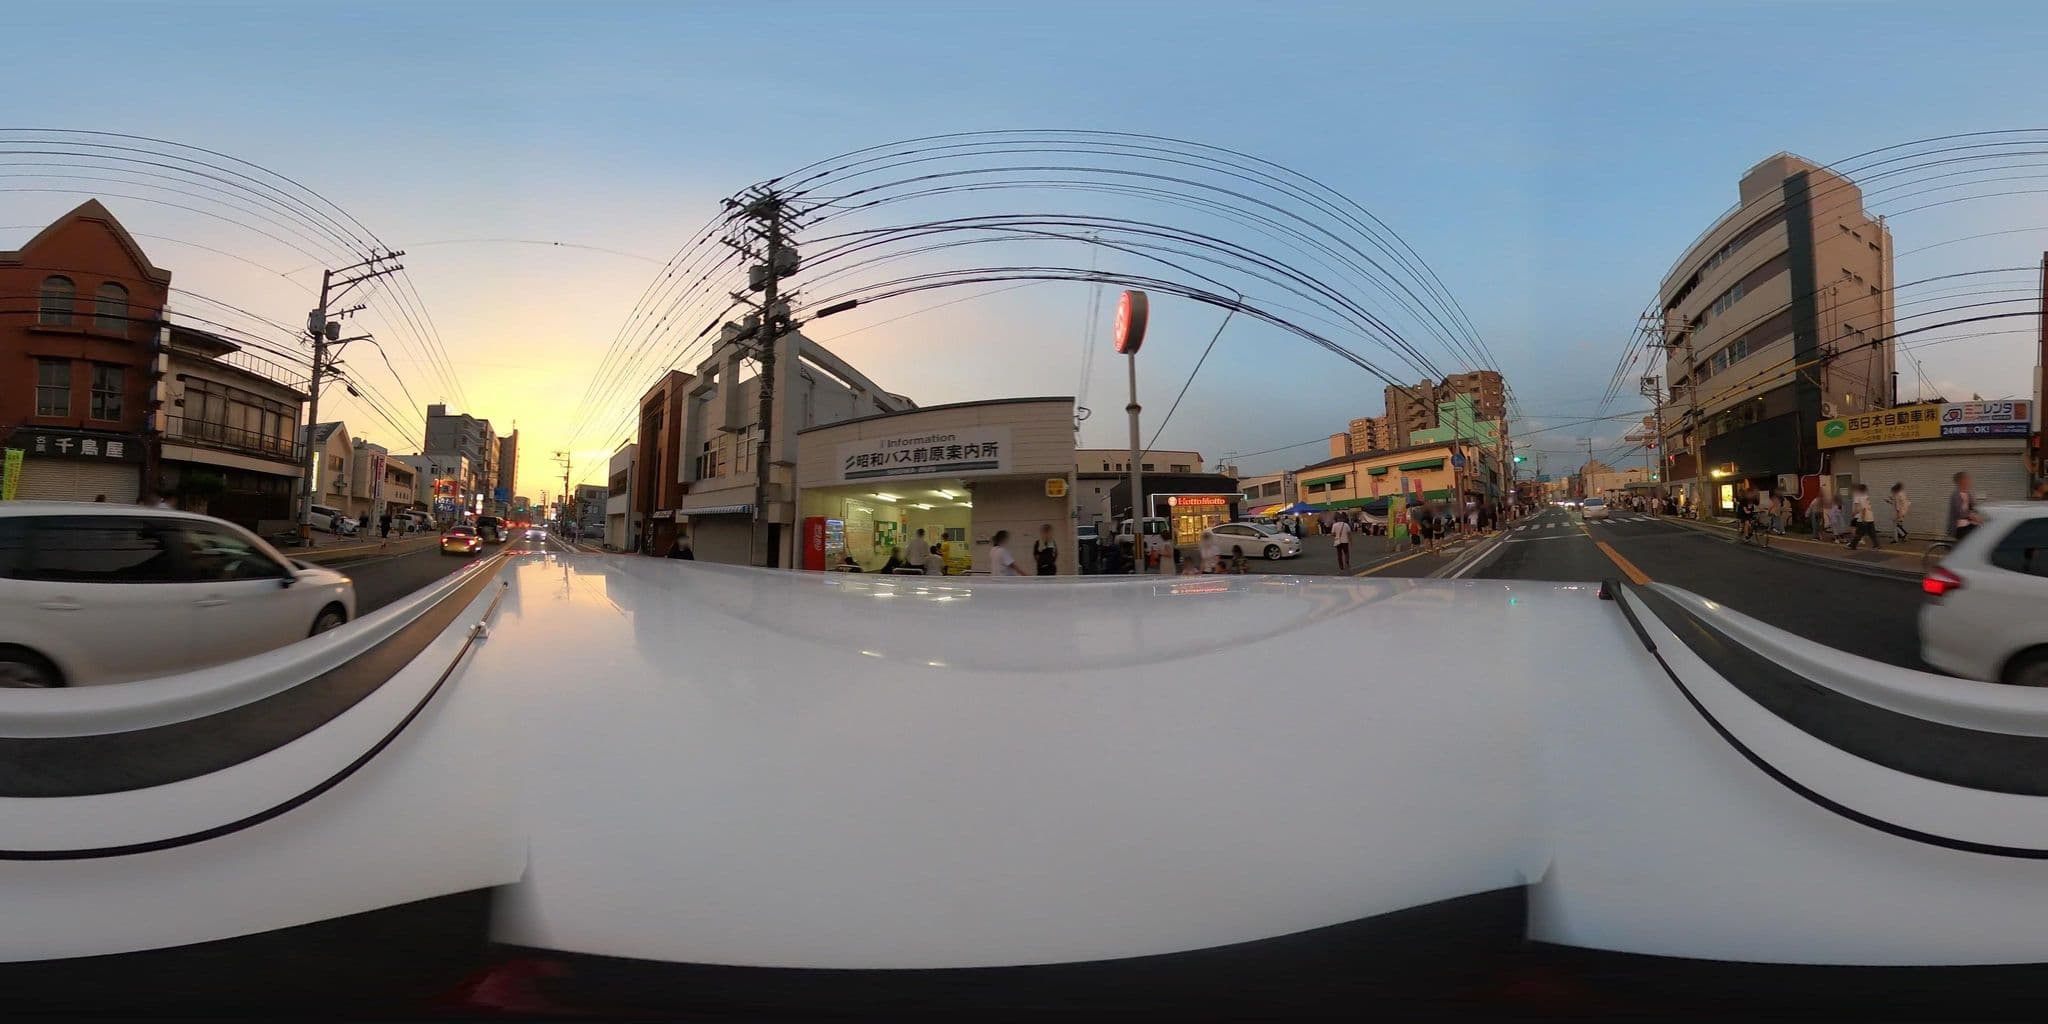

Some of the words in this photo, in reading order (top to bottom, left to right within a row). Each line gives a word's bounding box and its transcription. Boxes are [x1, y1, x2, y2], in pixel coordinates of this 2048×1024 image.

[55, 438, 124, 458] 千鳥屋
[887, 433, 956, 448] Information
[857, 442, 999, 468] 昭和バス前原案内所
